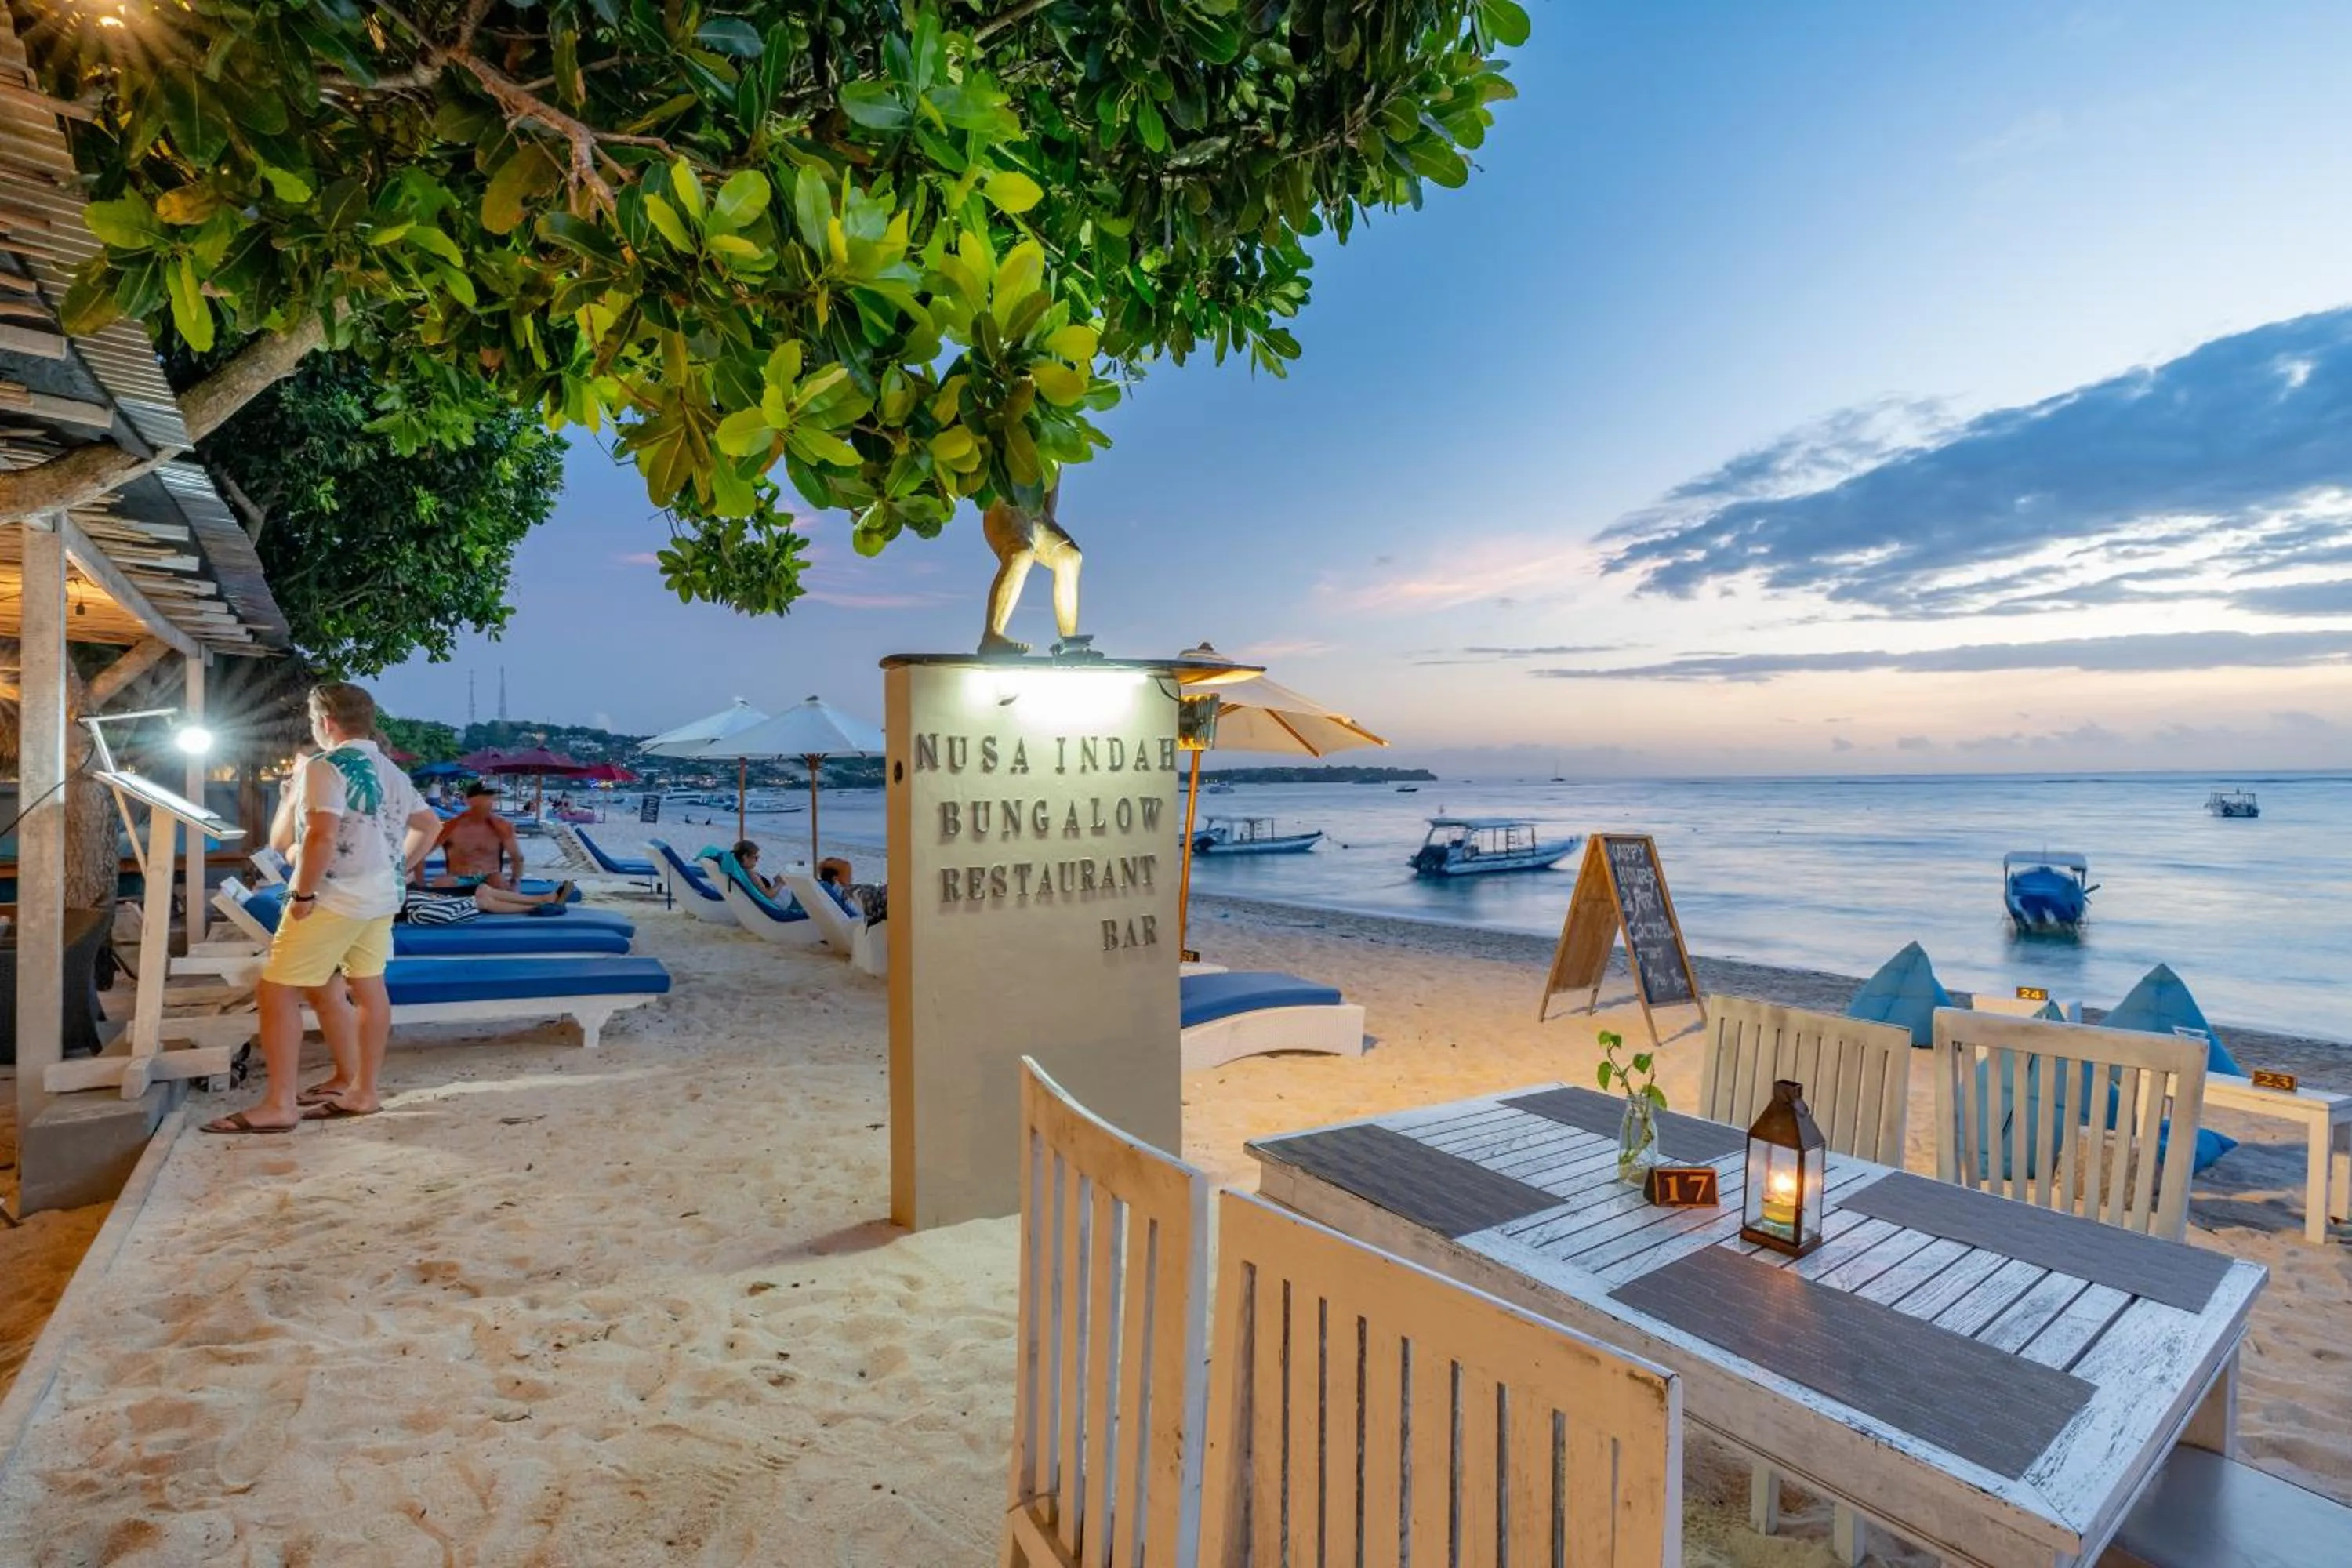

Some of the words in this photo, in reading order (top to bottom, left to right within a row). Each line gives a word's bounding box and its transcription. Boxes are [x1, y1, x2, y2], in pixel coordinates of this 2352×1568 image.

[915, 732, 1029, 774] NUSA
[1055, 736, 1178, 774] INDAH
[939, 797, 1163, 837] BUNGALOW
[940, 854, 1156, 903] RESTAURANT
[1102, 914, 1158, 950] BAR
[2020, 989, 2042, 1000] 24
[2258, 1073, 2290, 1089] 23
[1666, 1175, 1708, 1203] 17
